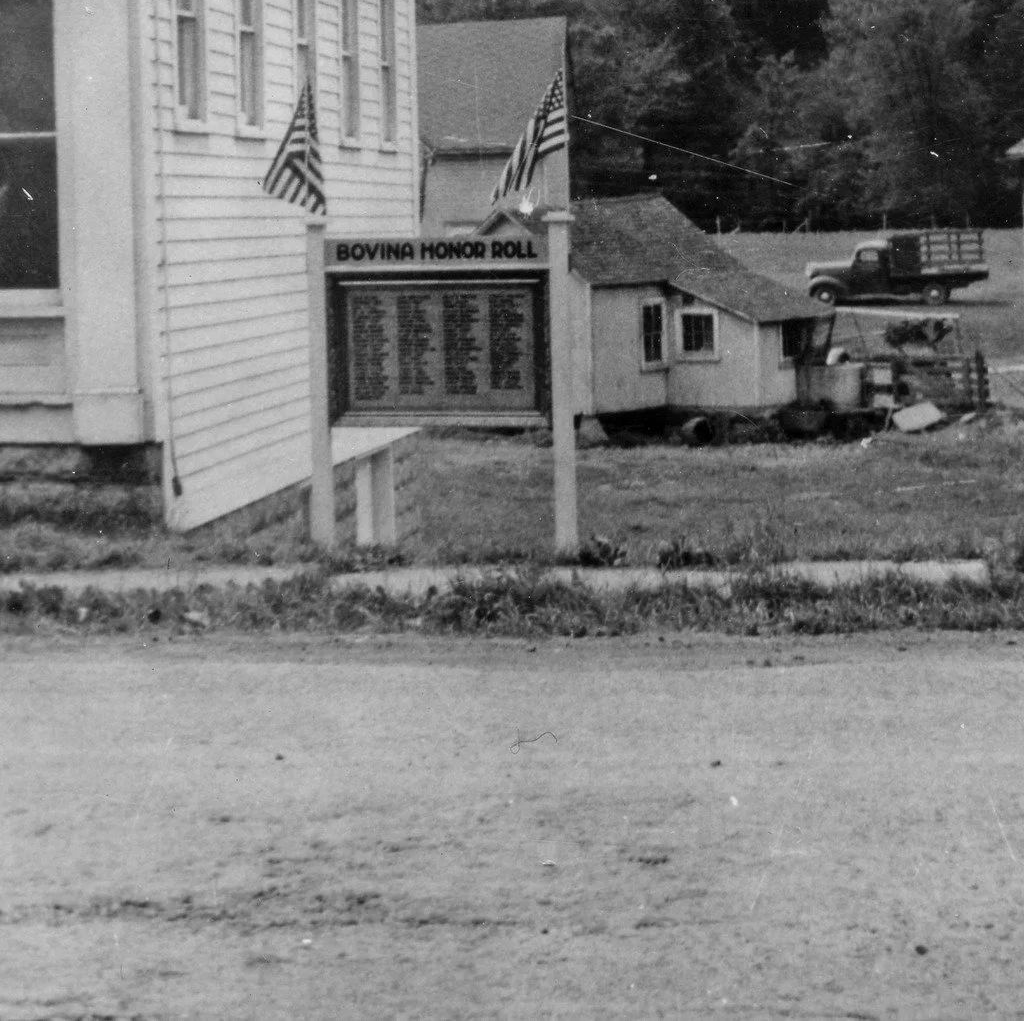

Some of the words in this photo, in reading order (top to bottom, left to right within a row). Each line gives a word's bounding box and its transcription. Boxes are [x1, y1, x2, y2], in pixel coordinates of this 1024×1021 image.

[336, 242, 414, 261] BOVINA
[420, 241, 487, 260] HONOR
[491, 240, 538, 259] ROLL
